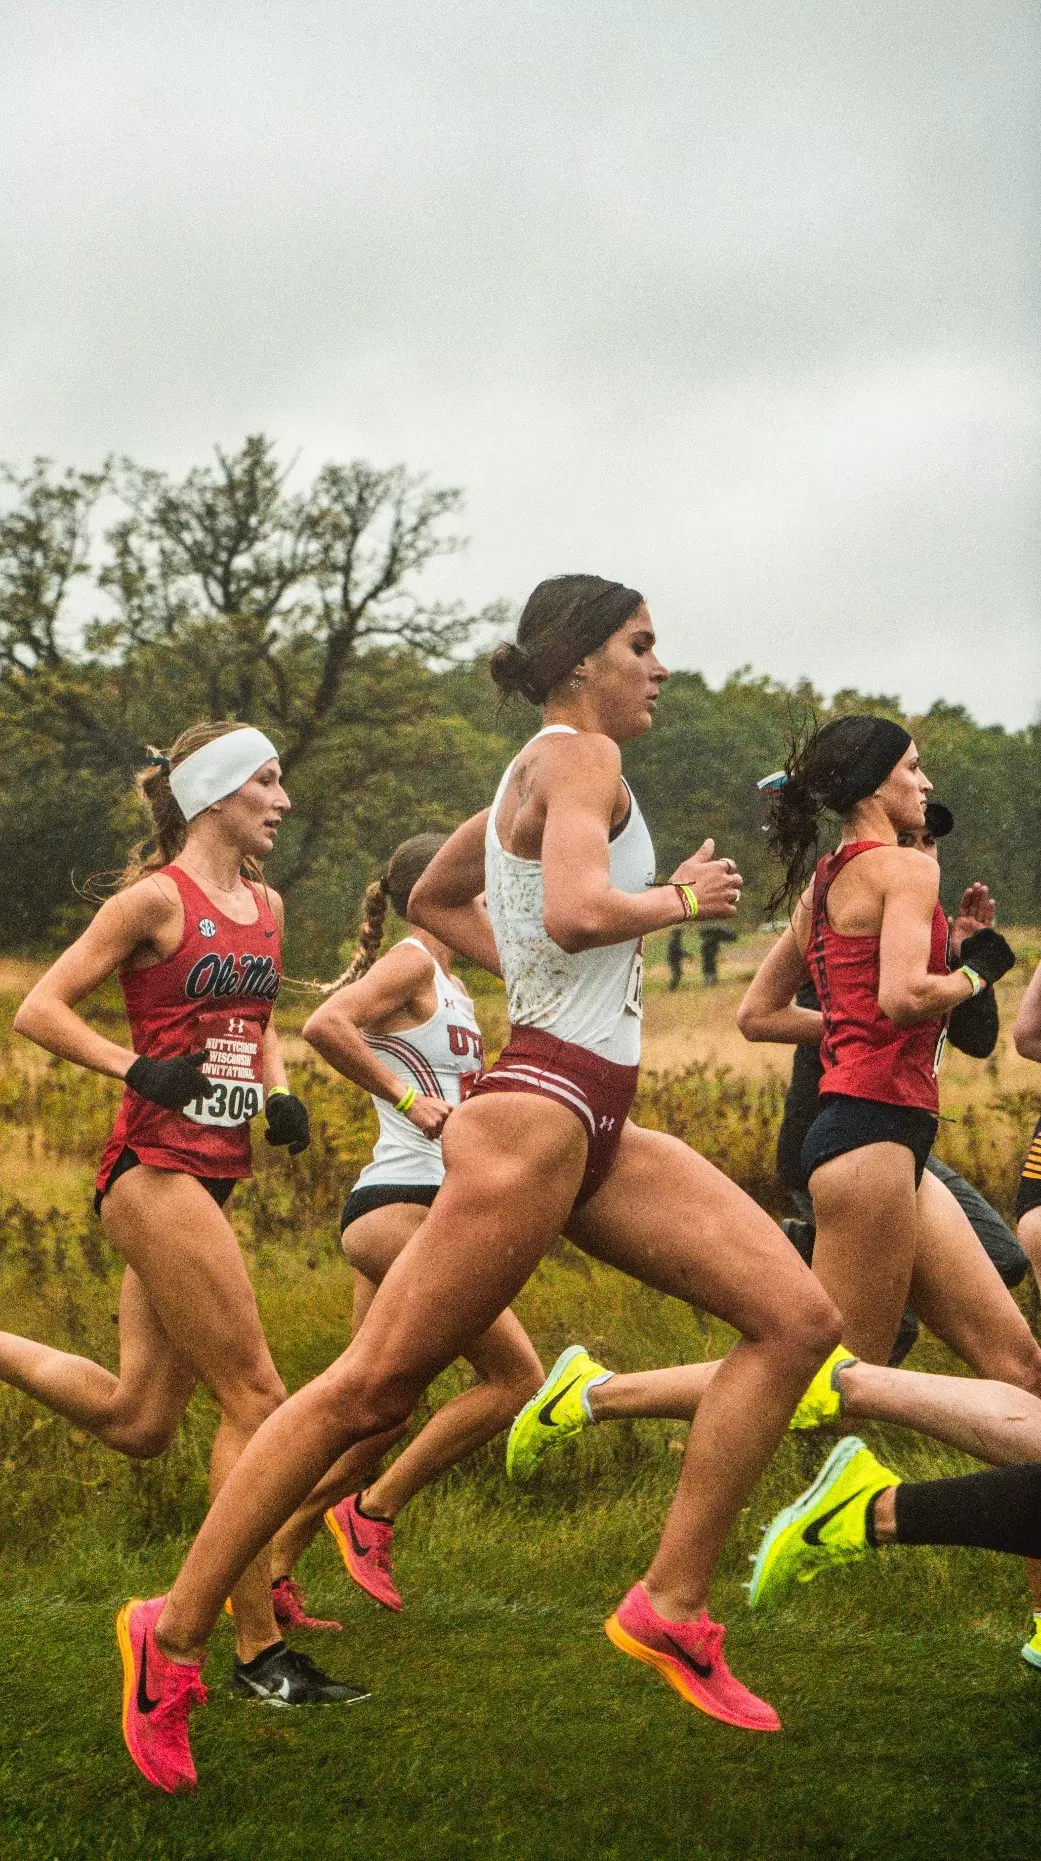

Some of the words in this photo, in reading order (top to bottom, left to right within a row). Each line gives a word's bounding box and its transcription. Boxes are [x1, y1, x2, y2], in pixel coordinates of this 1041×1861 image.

[184, 952, 240, 1000] Ole
[205, 1037, 258, 1055] NUTTYCOMBE
[209, 1050, 252, 1067] WISCONSIN
[202, 1062, 256, 1080] INVITATIONAL
[195, 1083, 259, 1120] 1309
